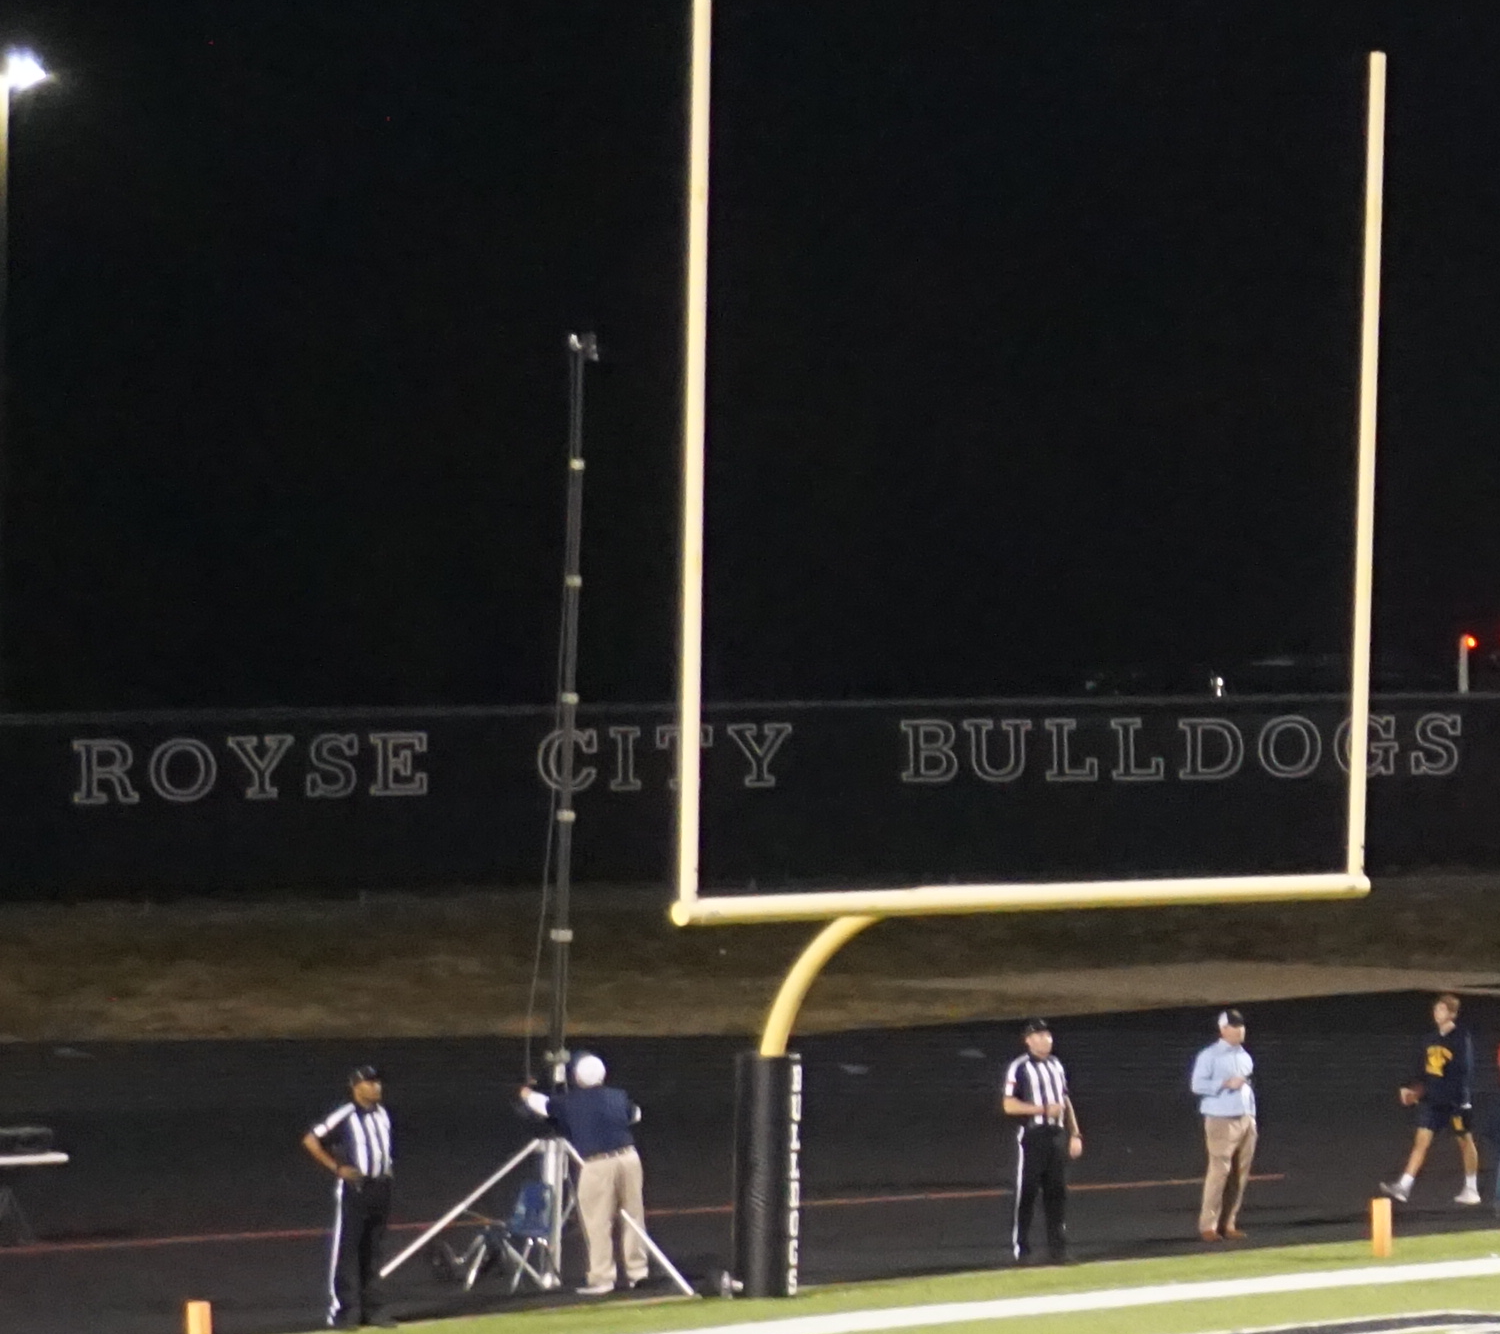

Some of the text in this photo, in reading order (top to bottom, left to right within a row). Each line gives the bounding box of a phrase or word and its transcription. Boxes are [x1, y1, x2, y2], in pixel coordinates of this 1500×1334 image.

[72, 713, 1463, 804] ROYSE CITY BULLDOGS
